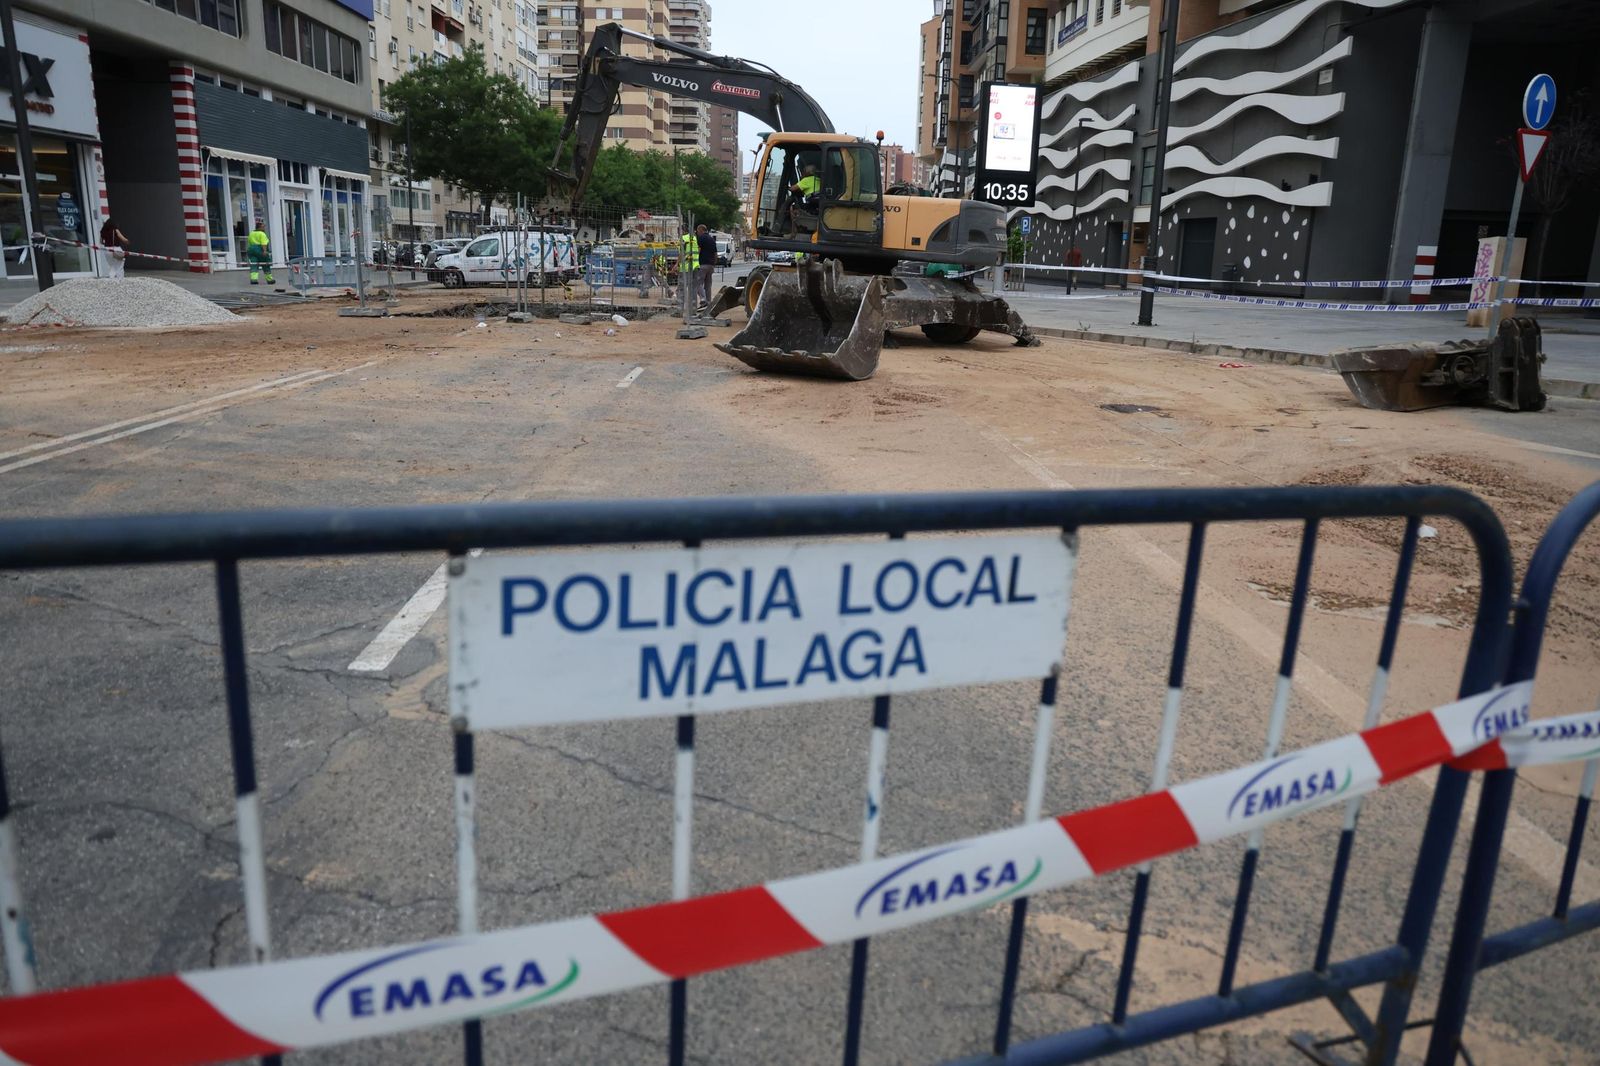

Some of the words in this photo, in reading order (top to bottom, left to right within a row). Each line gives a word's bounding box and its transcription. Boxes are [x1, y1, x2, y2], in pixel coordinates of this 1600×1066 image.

[651, 72, 699, 91] VOLVO
[983, 183, 1029, 200] 10:35
[63, 215, 75, 226] 50
[501, 567, 801, 636] POLICIA
[838, 555, 1037, 616] LOCAL
[638, 626, 927, 701] MALAGA
[1243, 769, 1336, 817] EMASA
[879, 861, 1020, 916] EMASA
[348, 960, 547, 1019] EMASA
